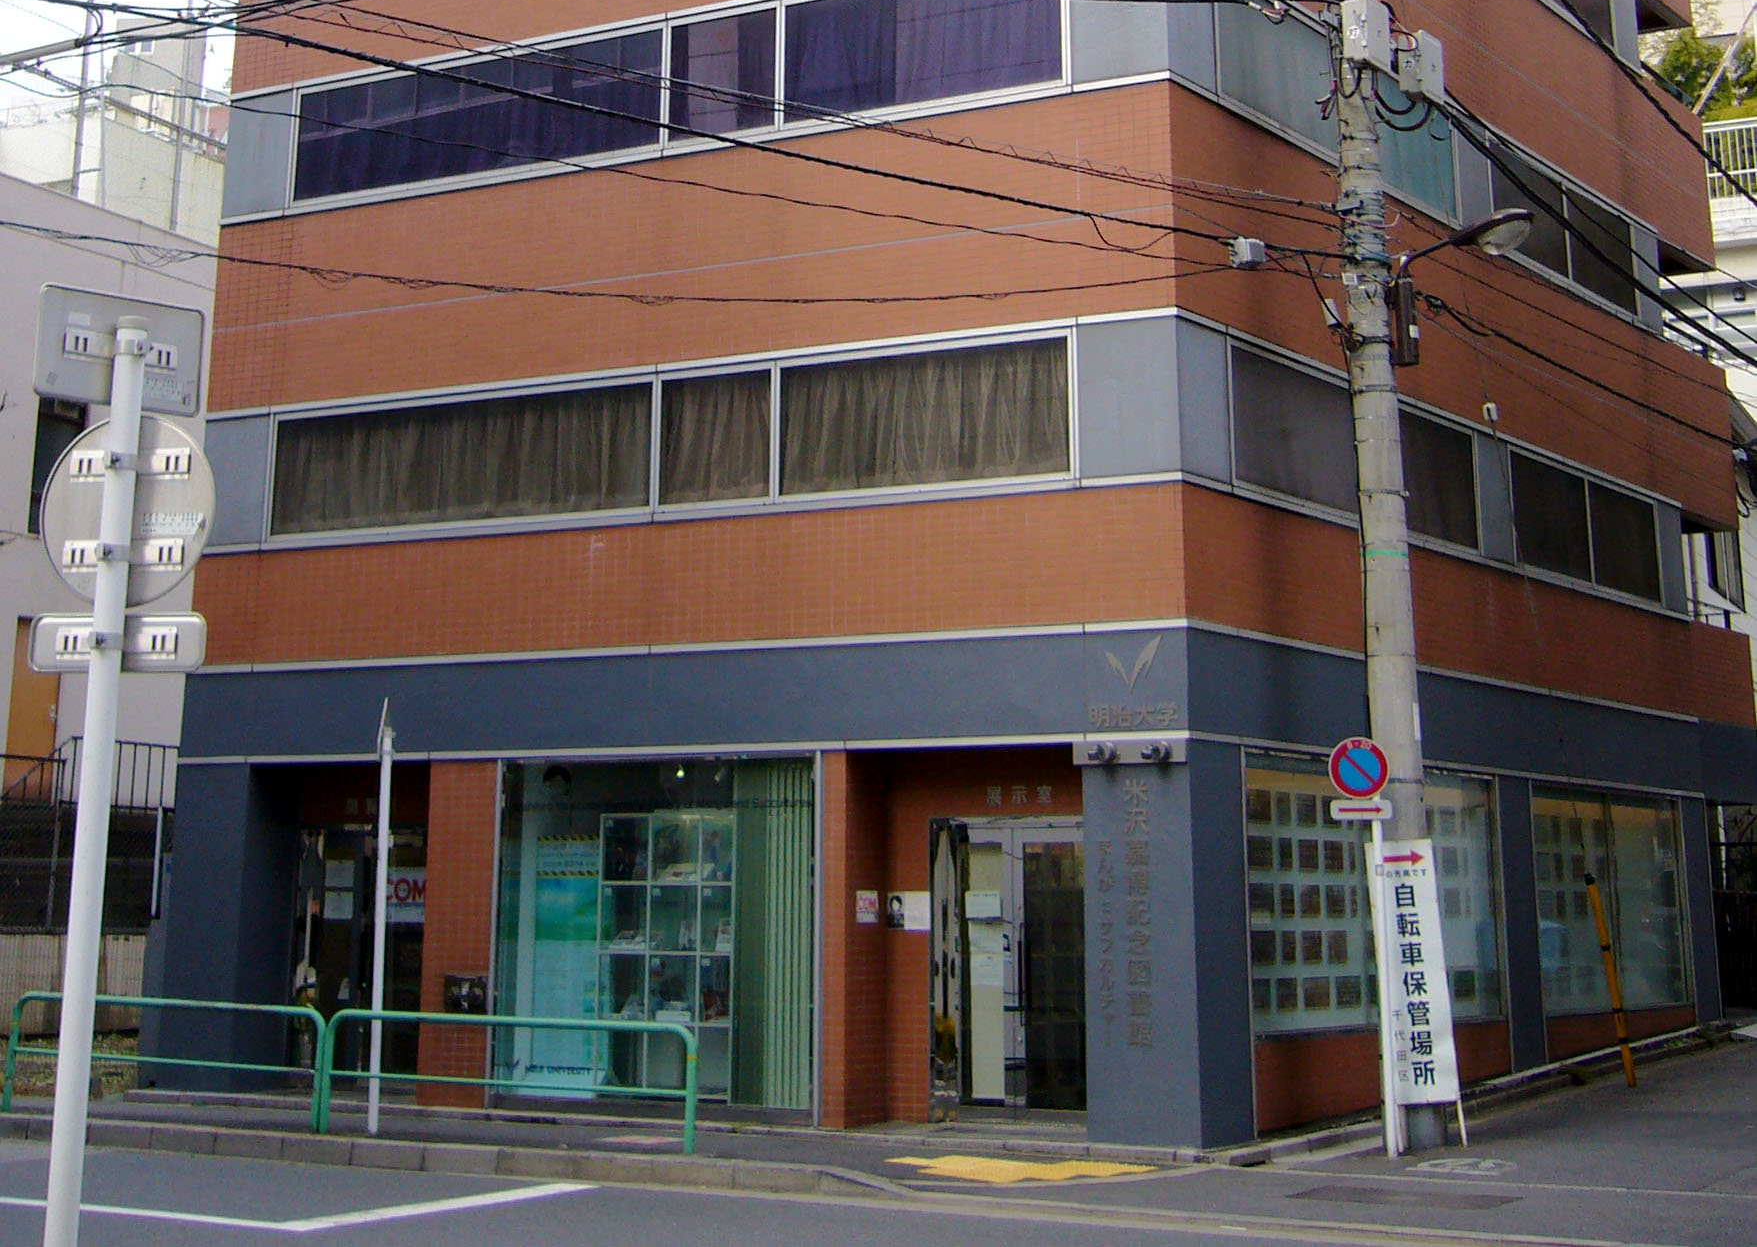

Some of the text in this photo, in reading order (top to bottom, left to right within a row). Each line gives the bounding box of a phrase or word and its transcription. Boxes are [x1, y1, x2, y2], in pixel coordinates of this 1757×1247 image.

[1088, 703, 1179, 729] 明治大学
[986, 785, 1053, 806] 展示室
[1394, 883, 1436, 1087] 自転車保管場所
[1392, 1009, 1410, 1083] 千代田区
